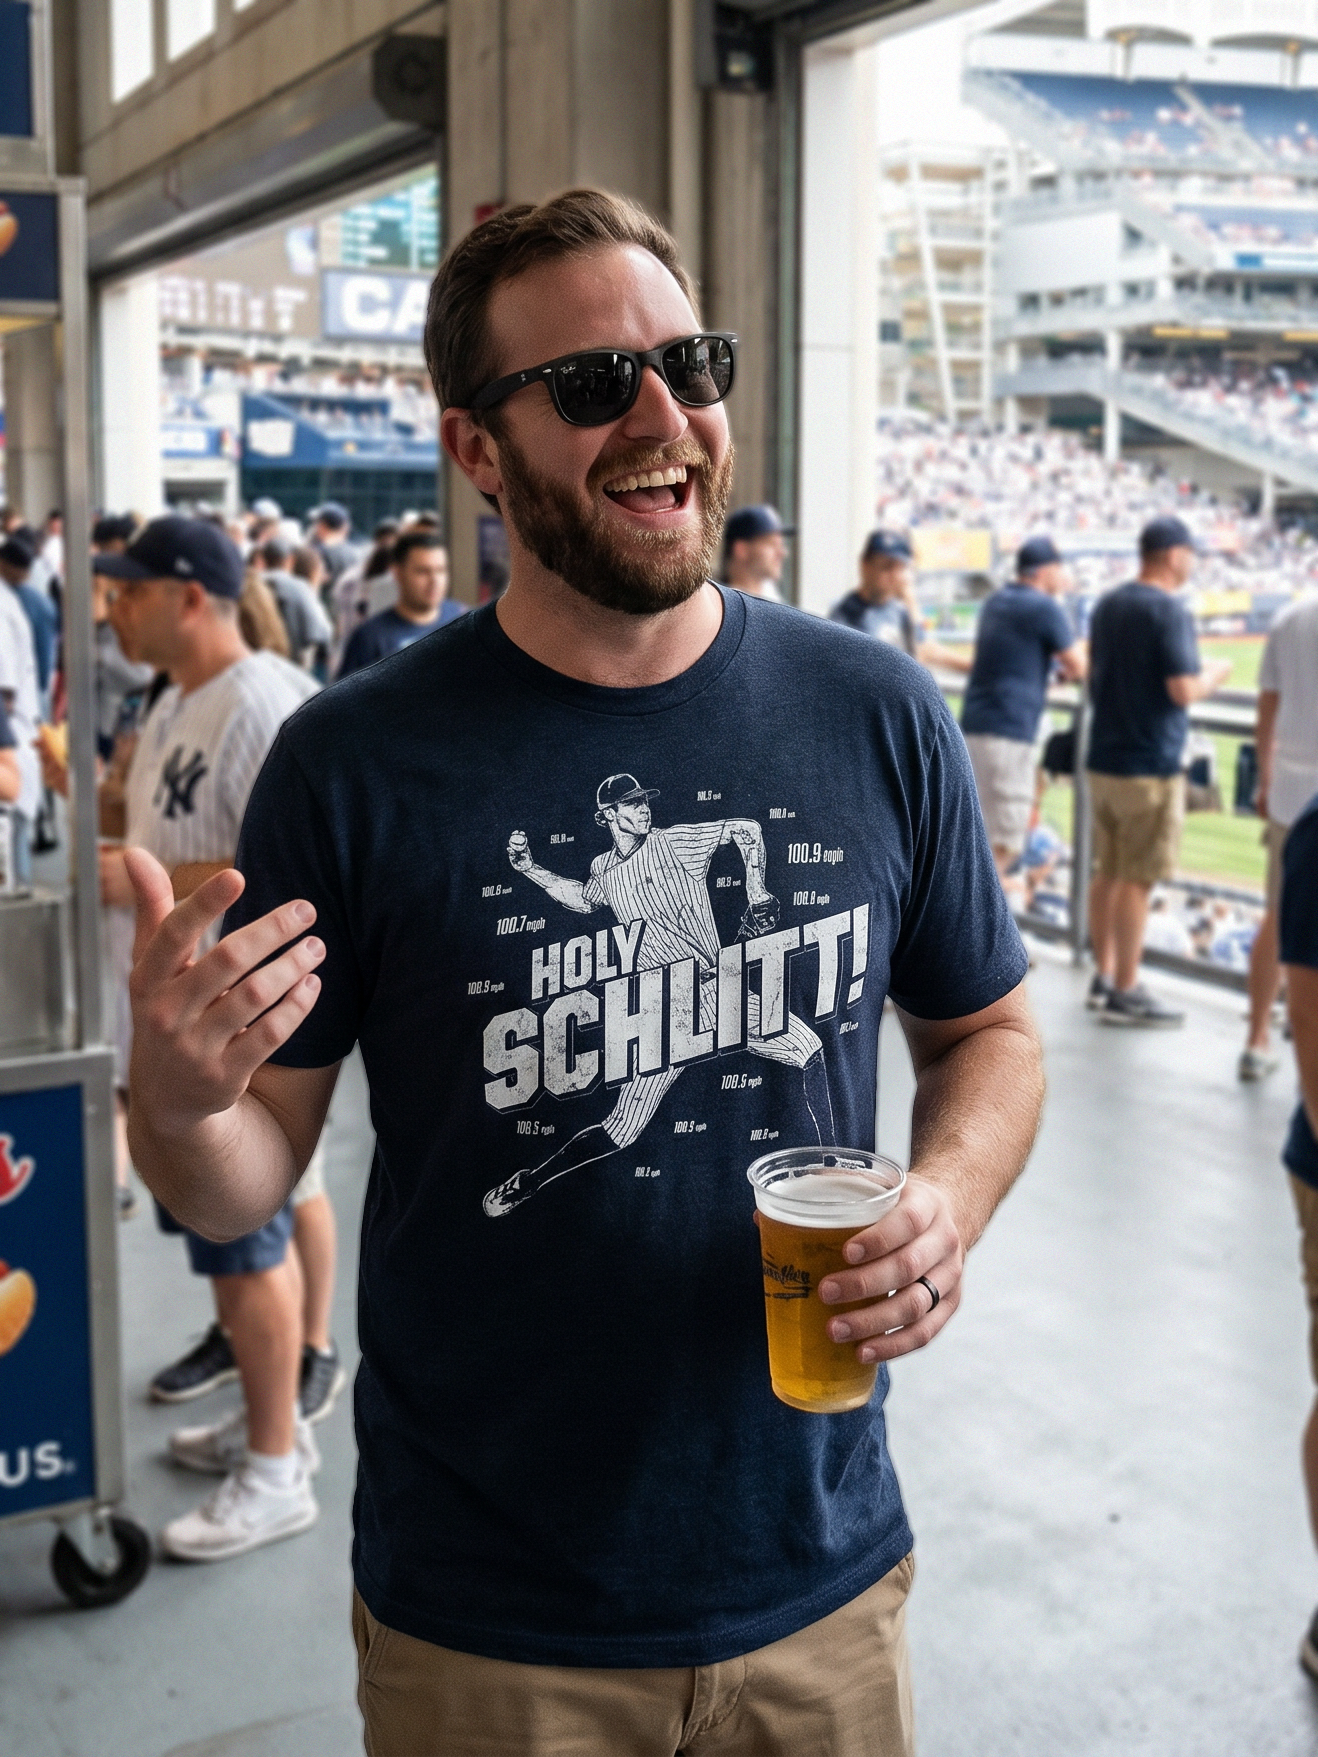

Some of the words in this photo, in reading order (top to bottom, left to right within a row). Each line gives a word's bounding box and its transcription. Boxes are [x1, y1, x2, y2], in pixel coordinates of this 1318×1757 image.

[788, 842, 821, 864] 100.9
[496, 915, 527, 936] 100.7
[531, 919, 644, 1000] HOLY
[483, 903, 870, 1110] SCHLITT!
